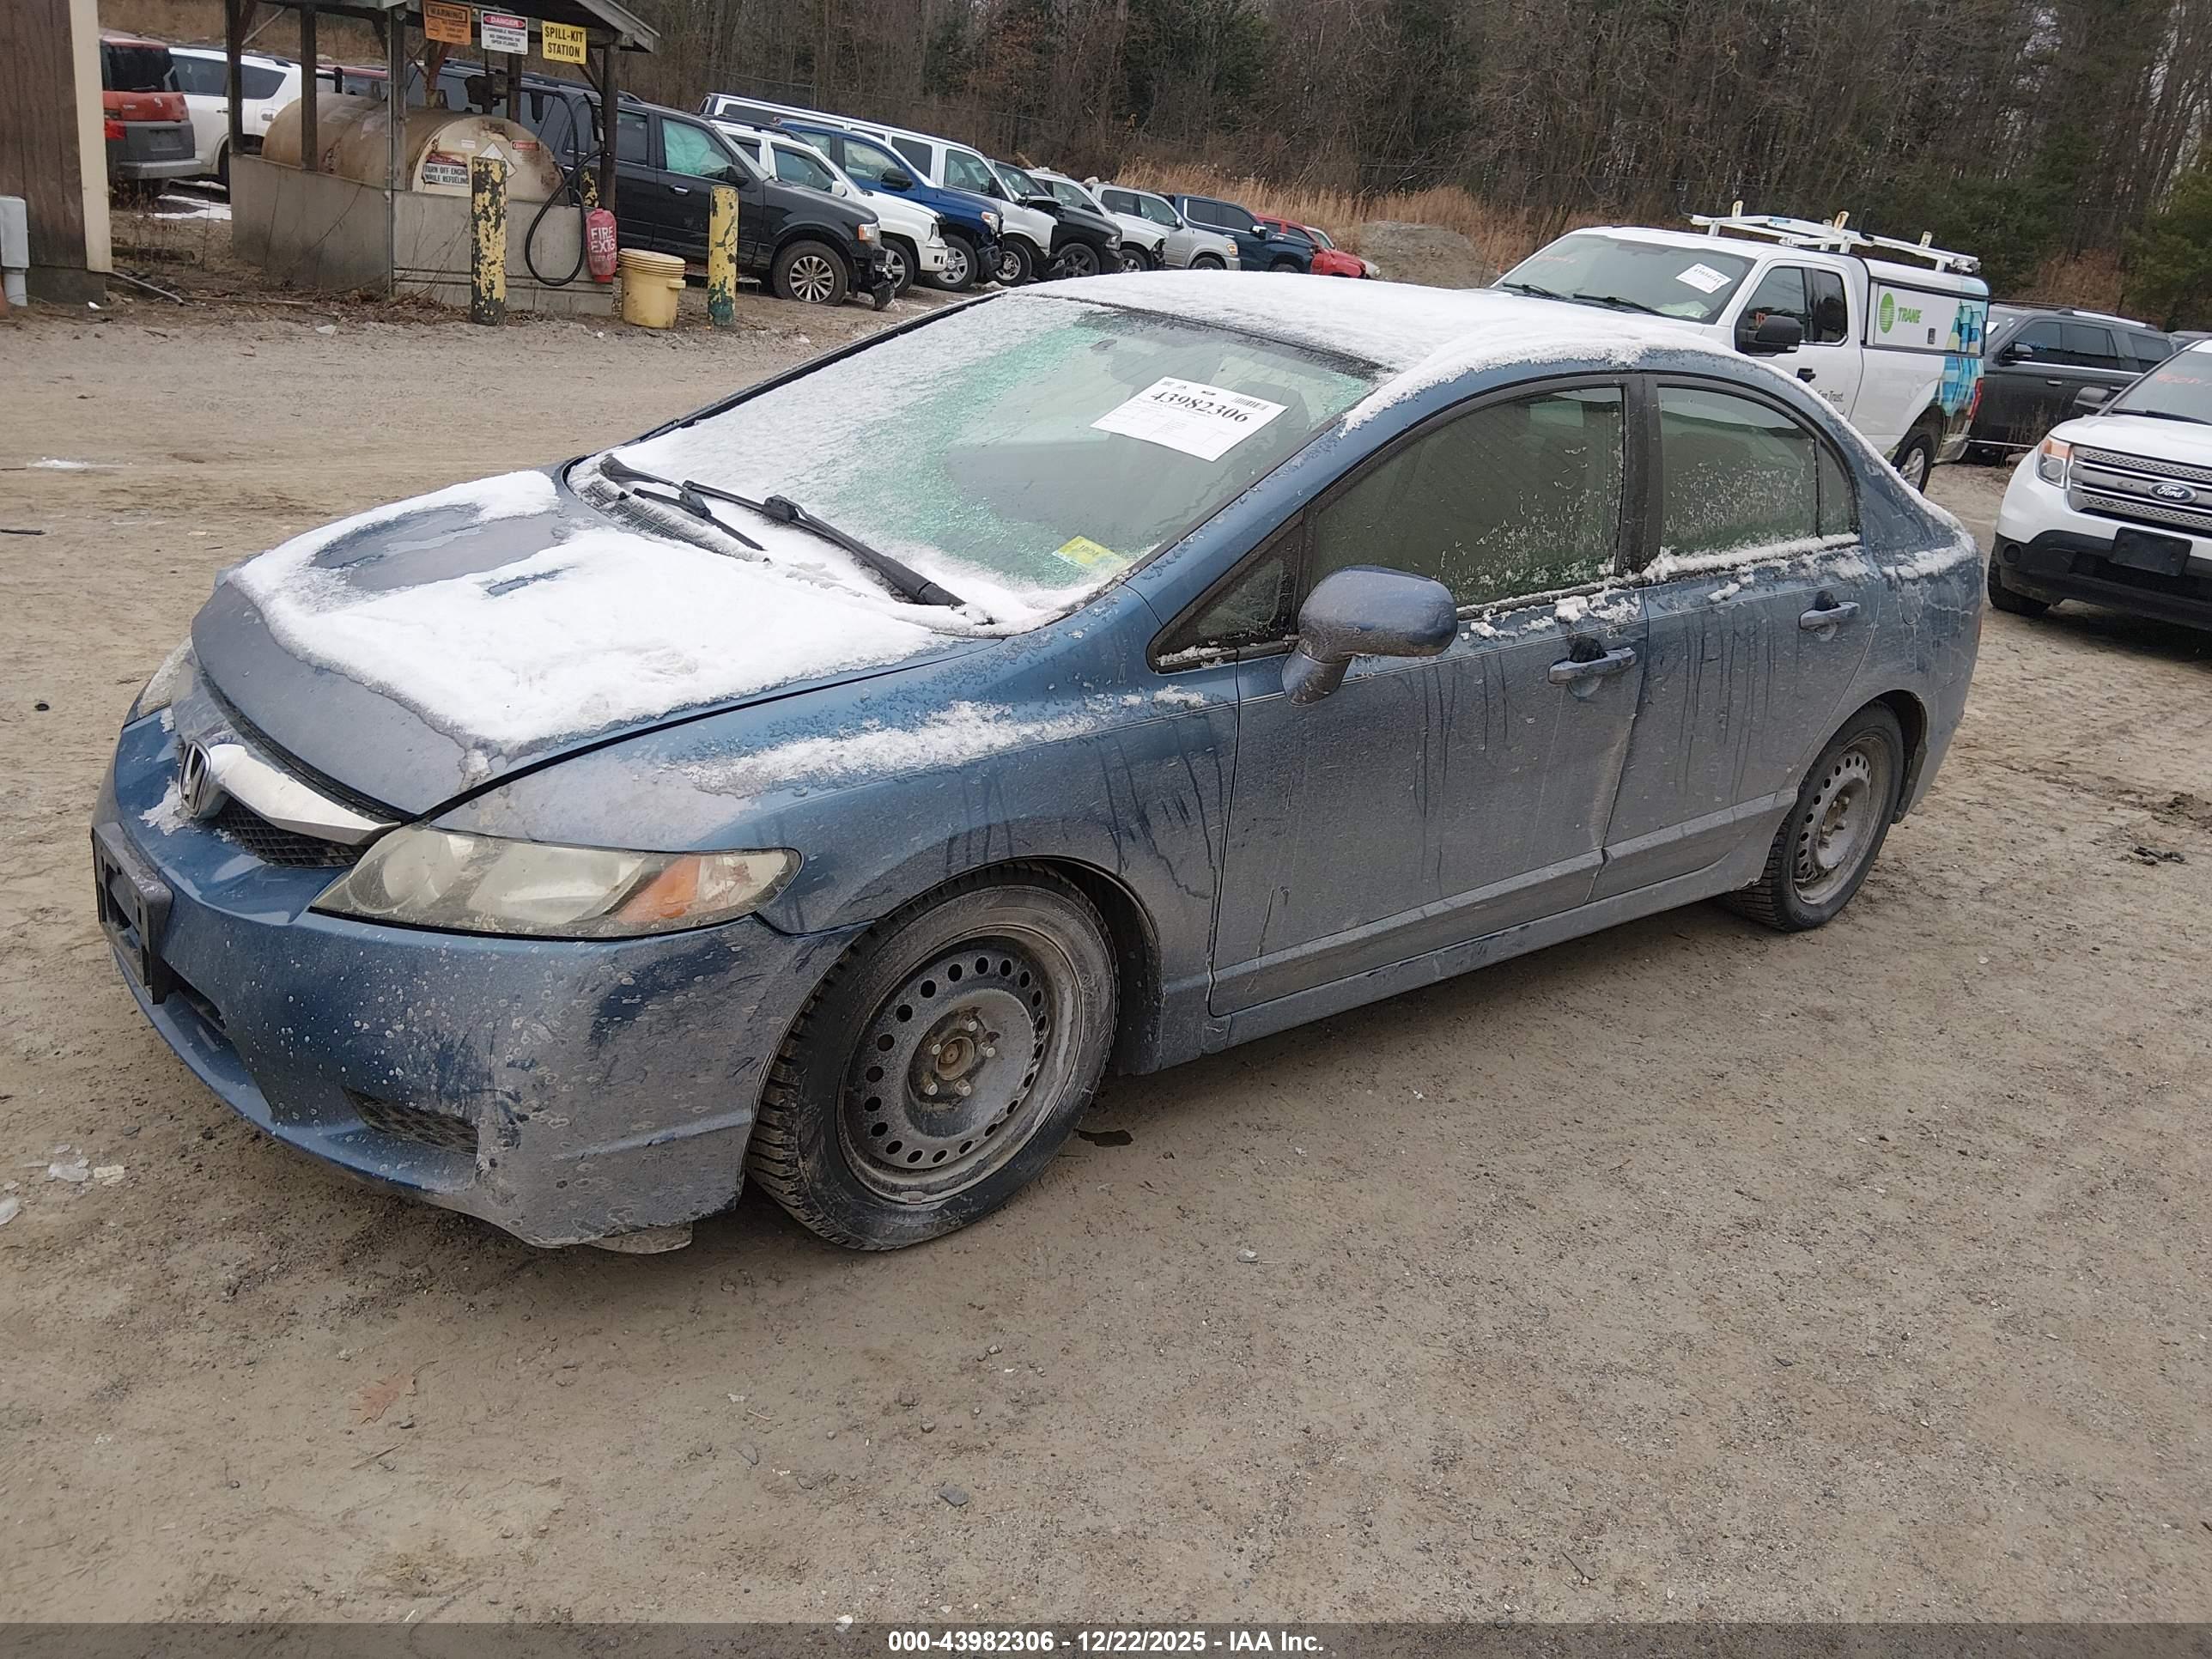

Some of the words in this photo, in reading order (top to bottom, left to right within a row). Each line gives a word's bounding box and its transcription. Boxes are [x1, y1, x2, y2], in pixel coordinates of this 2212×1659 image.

[544, 26, 584, 43] SPILL-KIT
[548, 42, 580, 58] STATION
[591, 226, 613, 240] FIRE
[1898, 307, 1923, 324] TRANE
[1151, 391, 1255, 422] 43982306
[2156, 484, 2185, 498] Ford
